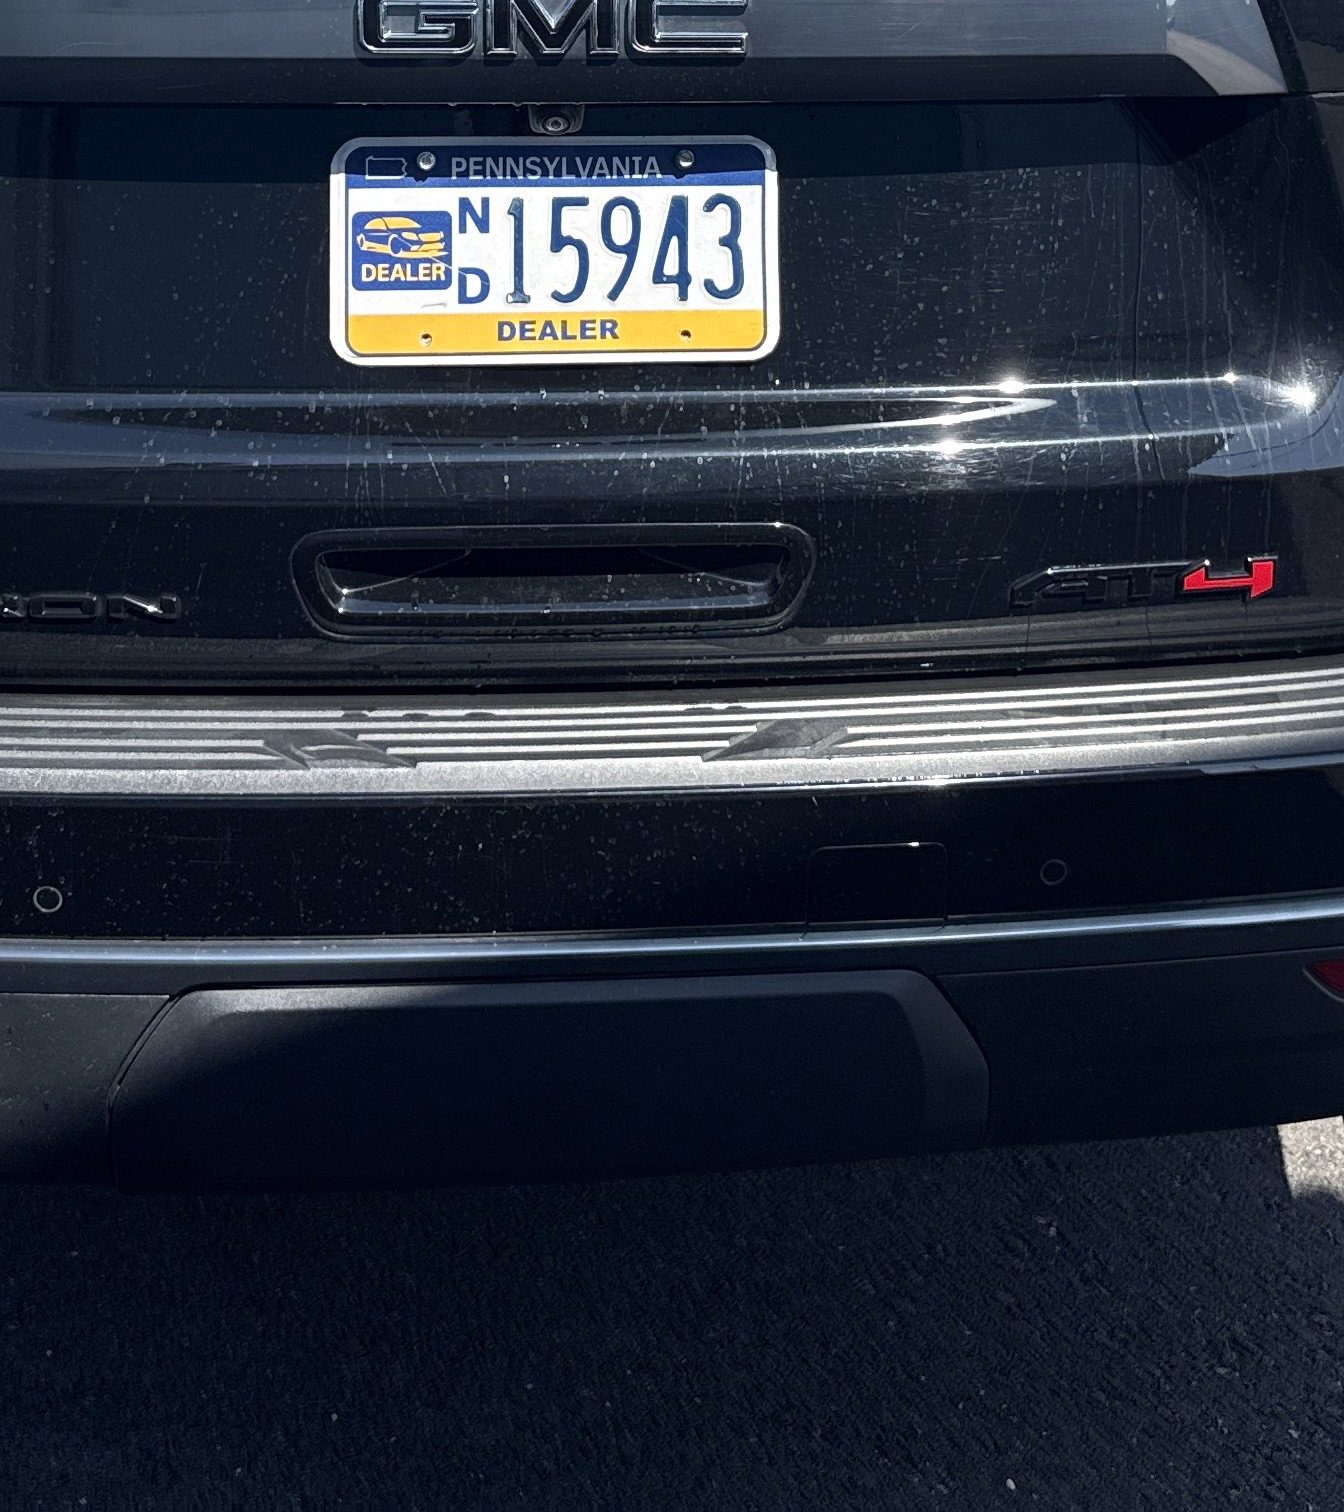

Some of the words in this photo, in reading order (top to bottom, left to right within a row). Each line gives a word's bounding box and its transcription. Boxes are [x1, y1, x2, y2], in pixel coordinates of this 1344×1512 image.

[451, 156, 663, 180] PENNSYLVANIA
[505, 193, 744, 304] 15943
[361, 263, 446, 282] DEALER
[498, 319, 619, 342] DEALER
